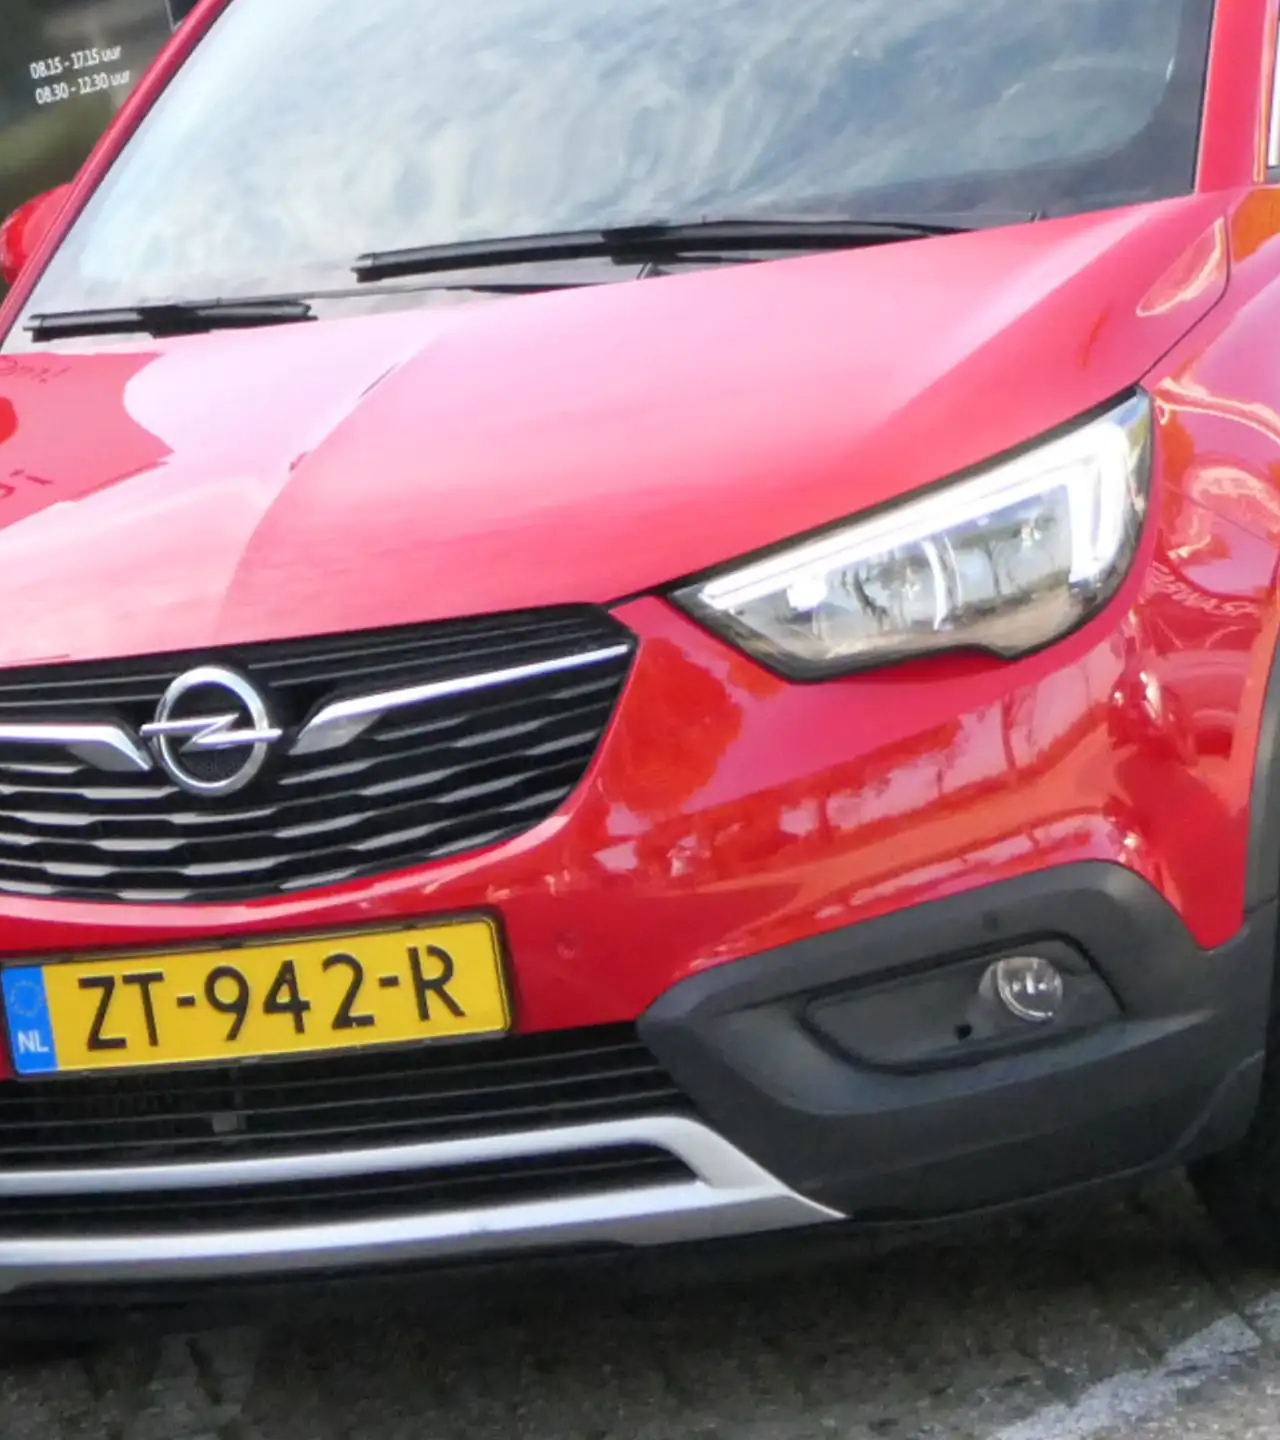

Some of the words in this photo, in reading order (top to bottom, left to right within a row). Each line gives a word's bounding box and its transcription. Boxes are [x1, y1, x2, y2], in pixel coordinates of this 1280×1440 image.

[29, 56, 64, 80] 08.15
[35, 81, 70, 105] 08.30
[77, 943, 467, 1053] ZT-942-R
[16, 1030, 50, 1054] NL
